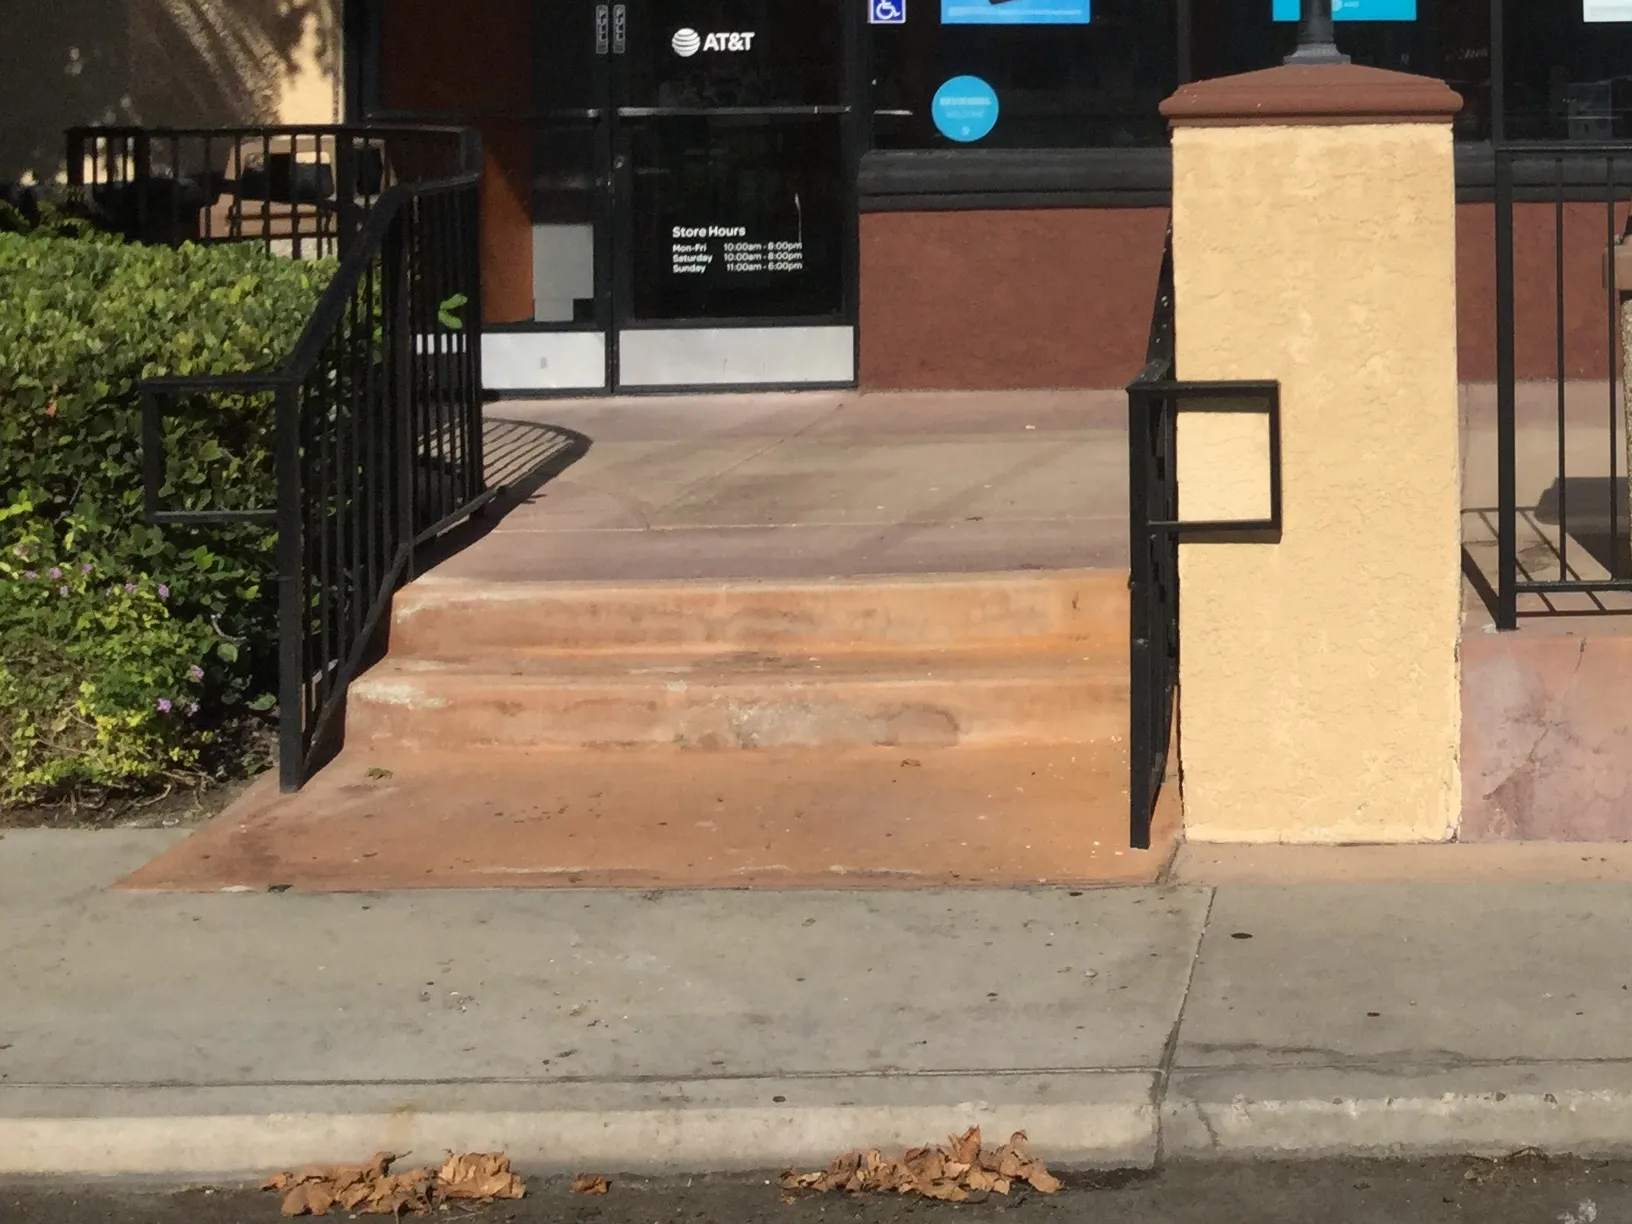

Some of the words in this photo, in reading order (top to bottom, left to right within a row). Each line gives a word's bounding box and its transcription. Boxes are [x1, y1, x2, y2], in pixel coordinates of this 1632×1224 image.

[703, 32, 756, 52] AT&T
[672, 226, 707, 238] Store
[708, 225, 746, 237] Hours
[672, 243, 707, 252] Mon-Fri
[723, 242, 762, 252] 10:00am
[767, 242, 803, 253] 8:00pm
[672, 253, 713, 264] Saturday
[723, 252, 762, 262] 10:00am
[767, 252, 803, 263] 8:00pm
[672, 263, 706, 274] Sunday
